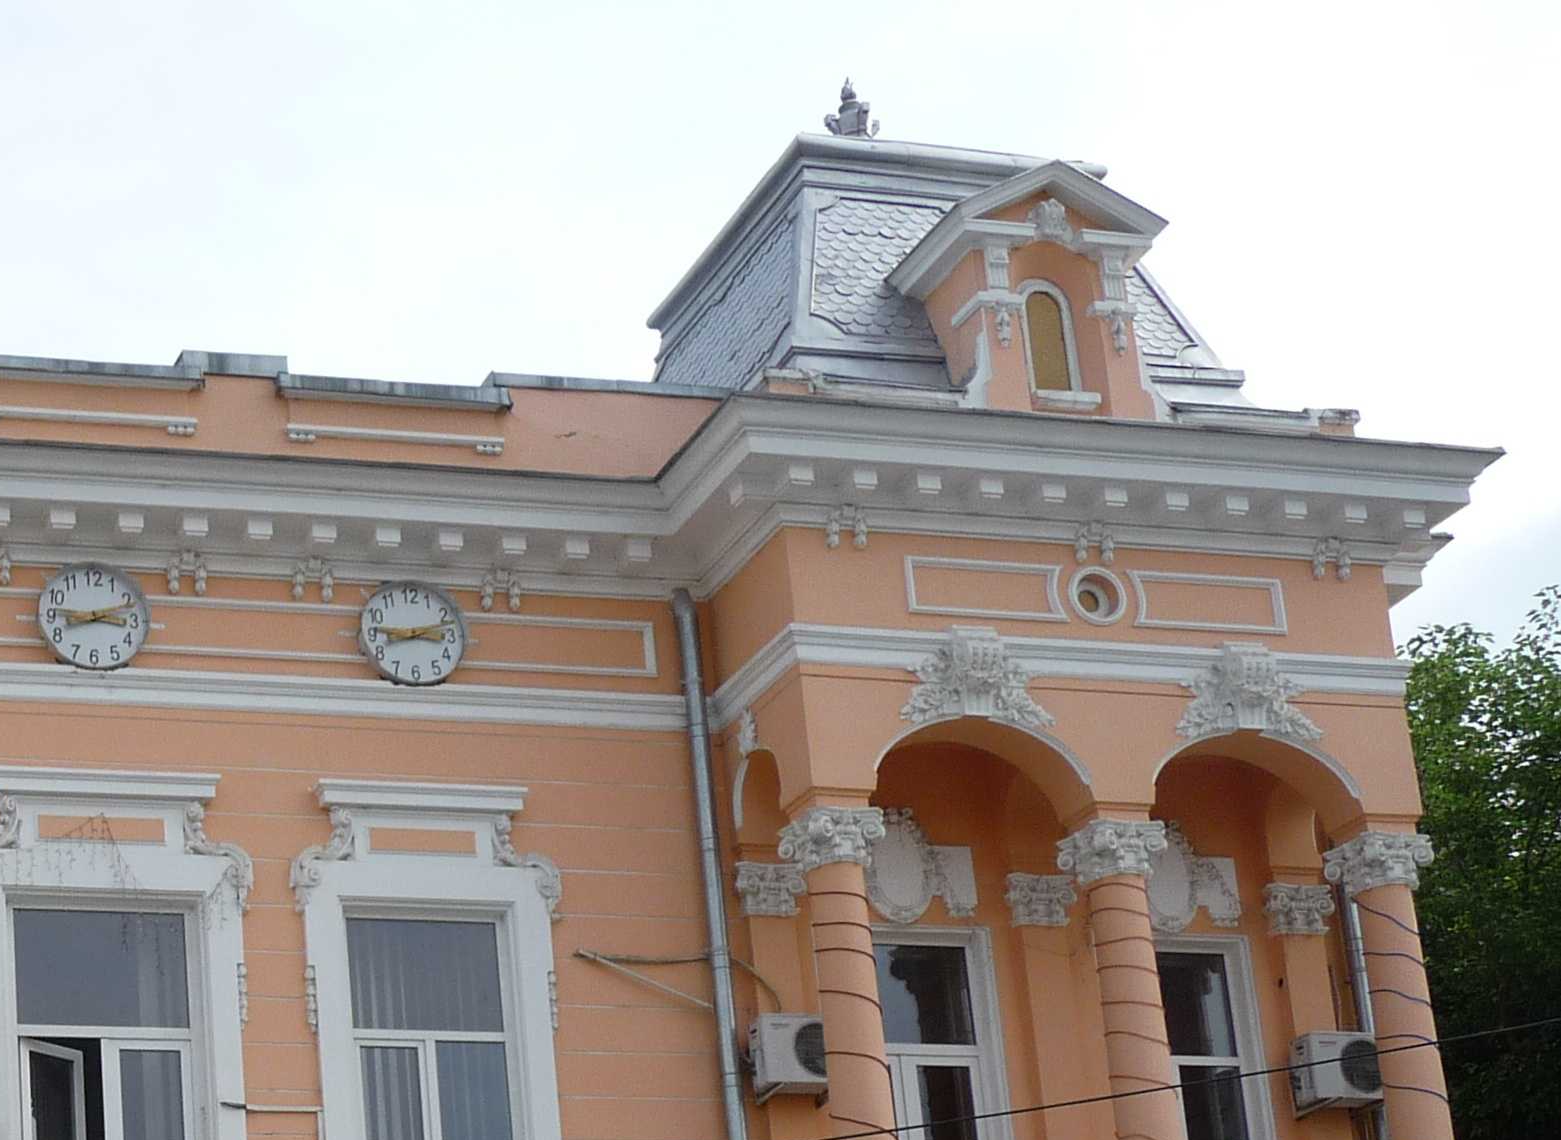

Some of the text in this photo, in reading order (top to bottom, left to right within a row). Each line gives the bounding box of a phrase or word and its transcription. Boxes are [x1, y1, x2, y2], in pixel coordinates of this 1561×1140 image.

[63, 574, 76, 591] 11
[84, 570, 103, 587] 12
[108, 577, 114, 593] 1
[48, 588, 64, 605] 10
[121, 592, 132, 608] 2
[382, 592, 395, 609] 11
[401, 587, 419, 604] 12
[424, 593, 430, 608] 1
[46, 608, 56, 624] 9
[130, 613, 139, 629] 3
[368, 607, 383, 624] 10
[439, 608, 451, 624] 2
[52, 627, 62, 643] 8
[123, 632, 132, 647] 4
[368, 627, 378, 642] 9
[447, 628, 456, 644] 3
[71, 644, 80, 659] 7
[89, 649, 99, 664] 6
[110, 645, 120, 661] 5
[375, 645, 384, 660] 8
[442, 647, 451, 662] 4
[392, 661, 400, 676] 7
[411, 665, 421, 680] 6
[431, 660, 441, 676] 5
